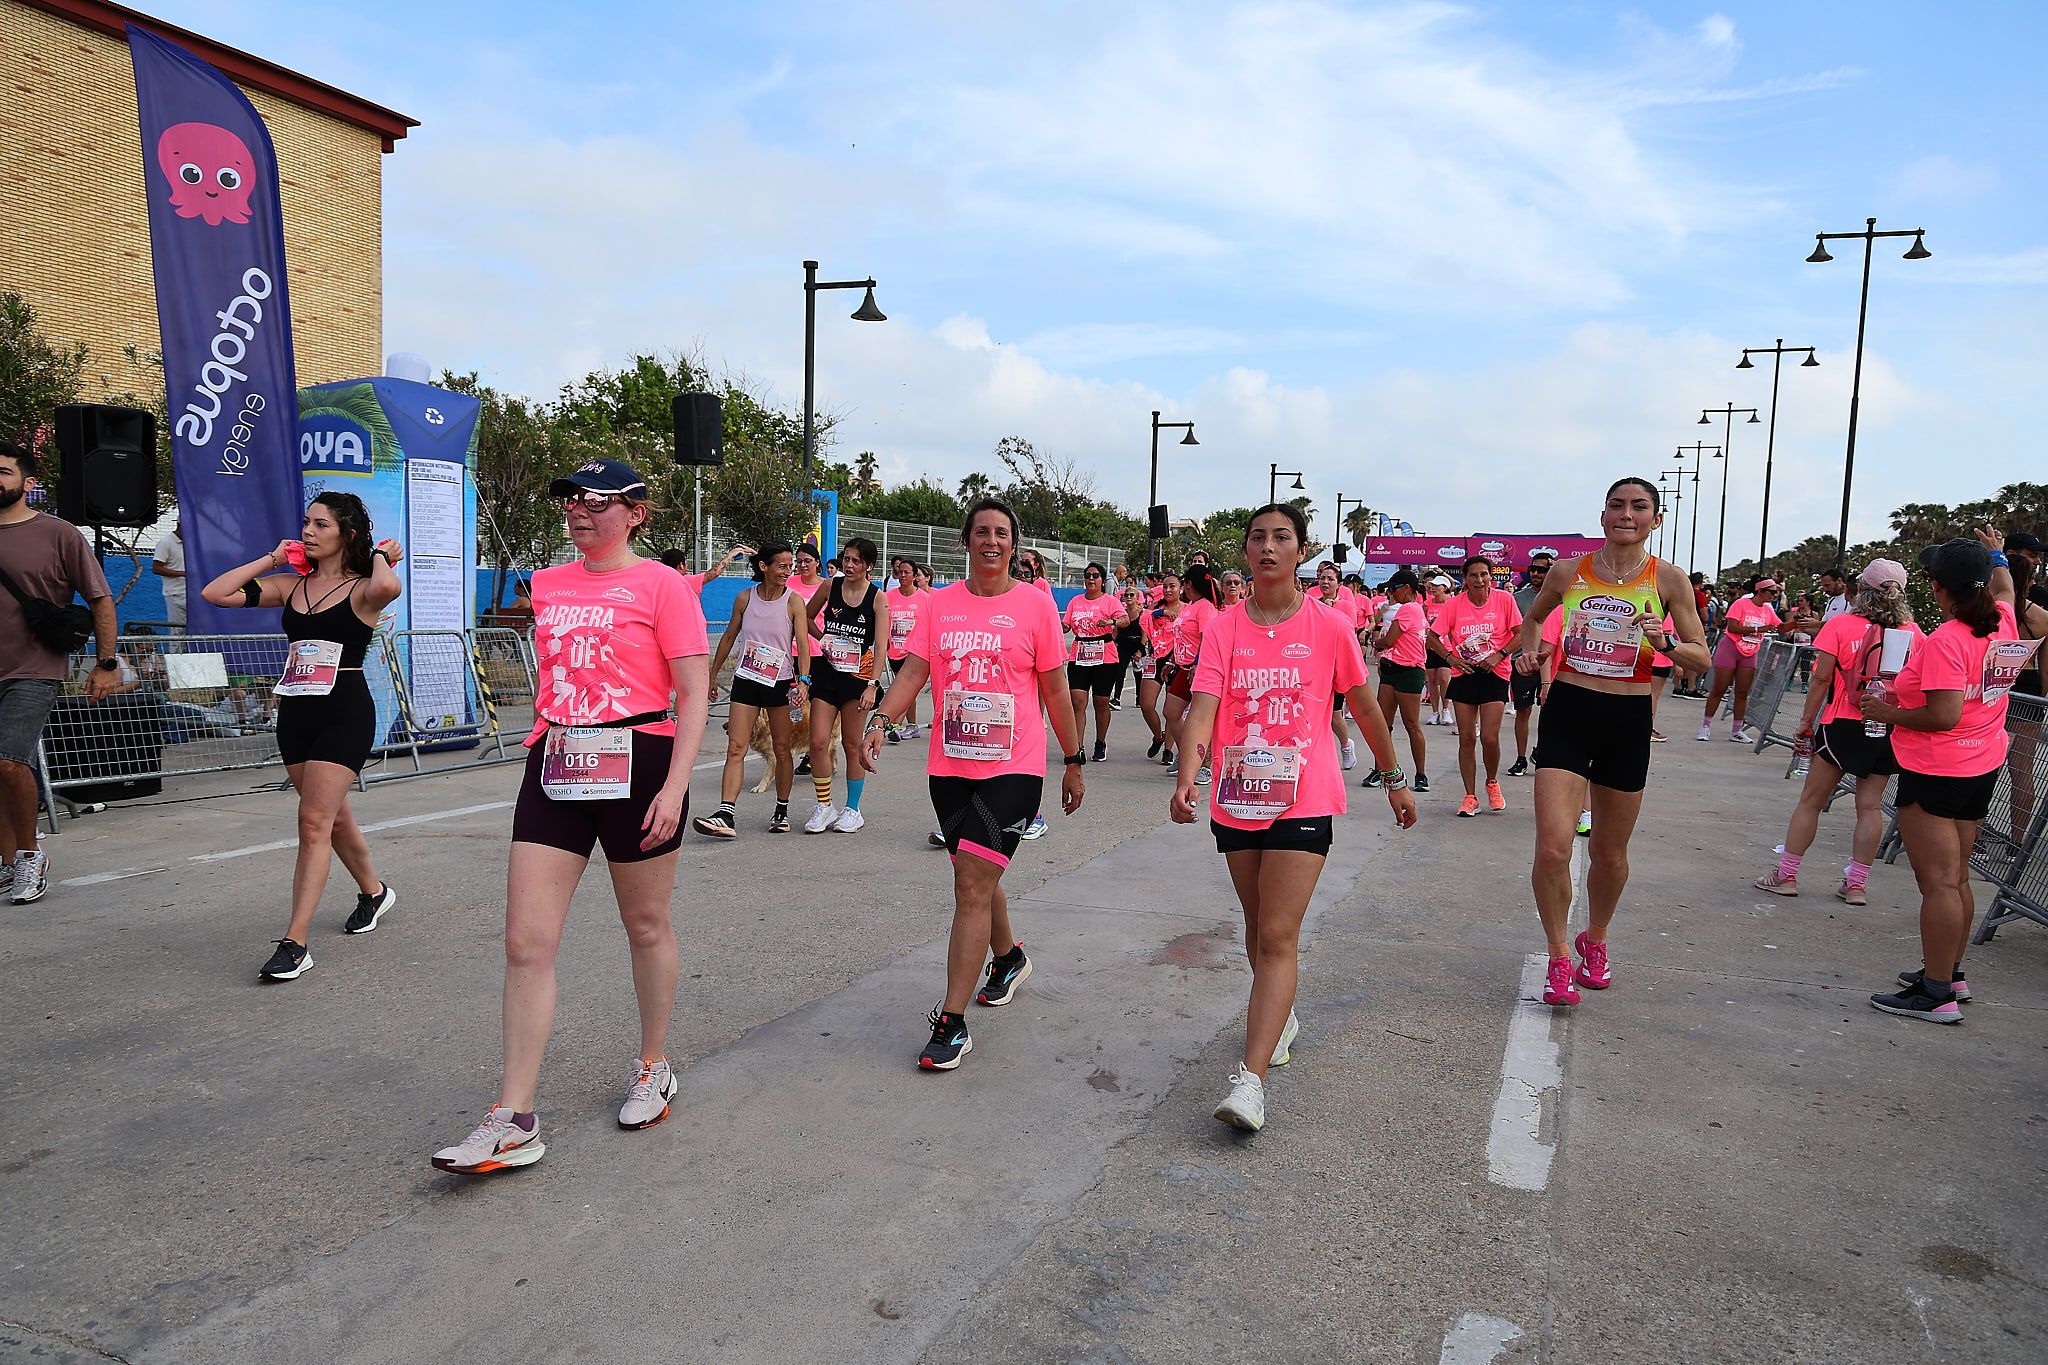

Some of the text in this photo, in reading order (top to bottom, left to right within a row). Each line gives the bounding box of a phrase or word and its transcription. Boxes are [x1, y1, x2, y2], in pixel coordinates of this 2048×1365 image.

[301, 432, 363, 465] OYA
[545, 590, 577, 599] OYSHO
[1582, 599, 1632, 614] Serrano
[537, 605, 614, 629] CARRERA
[940, 614, 967, 623] OYSHO
[826, 620, 866, 636] VALENCIA
[1461, 623, 1495, 635] CARRERA
[1591, 620, 1619, 630] ASTURIANA
[940, 631, 1001, 652] CARRERA
[1585, 640, 1615, 653] 016
[570, 635, 597, 669] DE
[831, 650, 848, 659] 016
[295, 664, 316, 675] 016
[752, 659, 768, 670] 016
[968, 656, 991, 684] DE
[1231, 668, 1302, 689] CARRERA
[569, 687, 590, 717] LA
[1267, 696, 1291, 725] DE
[568, 727, 601, 735] ASTURIANA
[962, 722, 989, 735] 016
[949, 747, 968, 755] OYSHO
[565, 753, 600, 768] 016
[571, 769, 589, 777] 2544
[550, 788, 572, 796] OYSHO
[589, 787, 619, 795] Santander
[1242, 779, 1271, 792] 016
